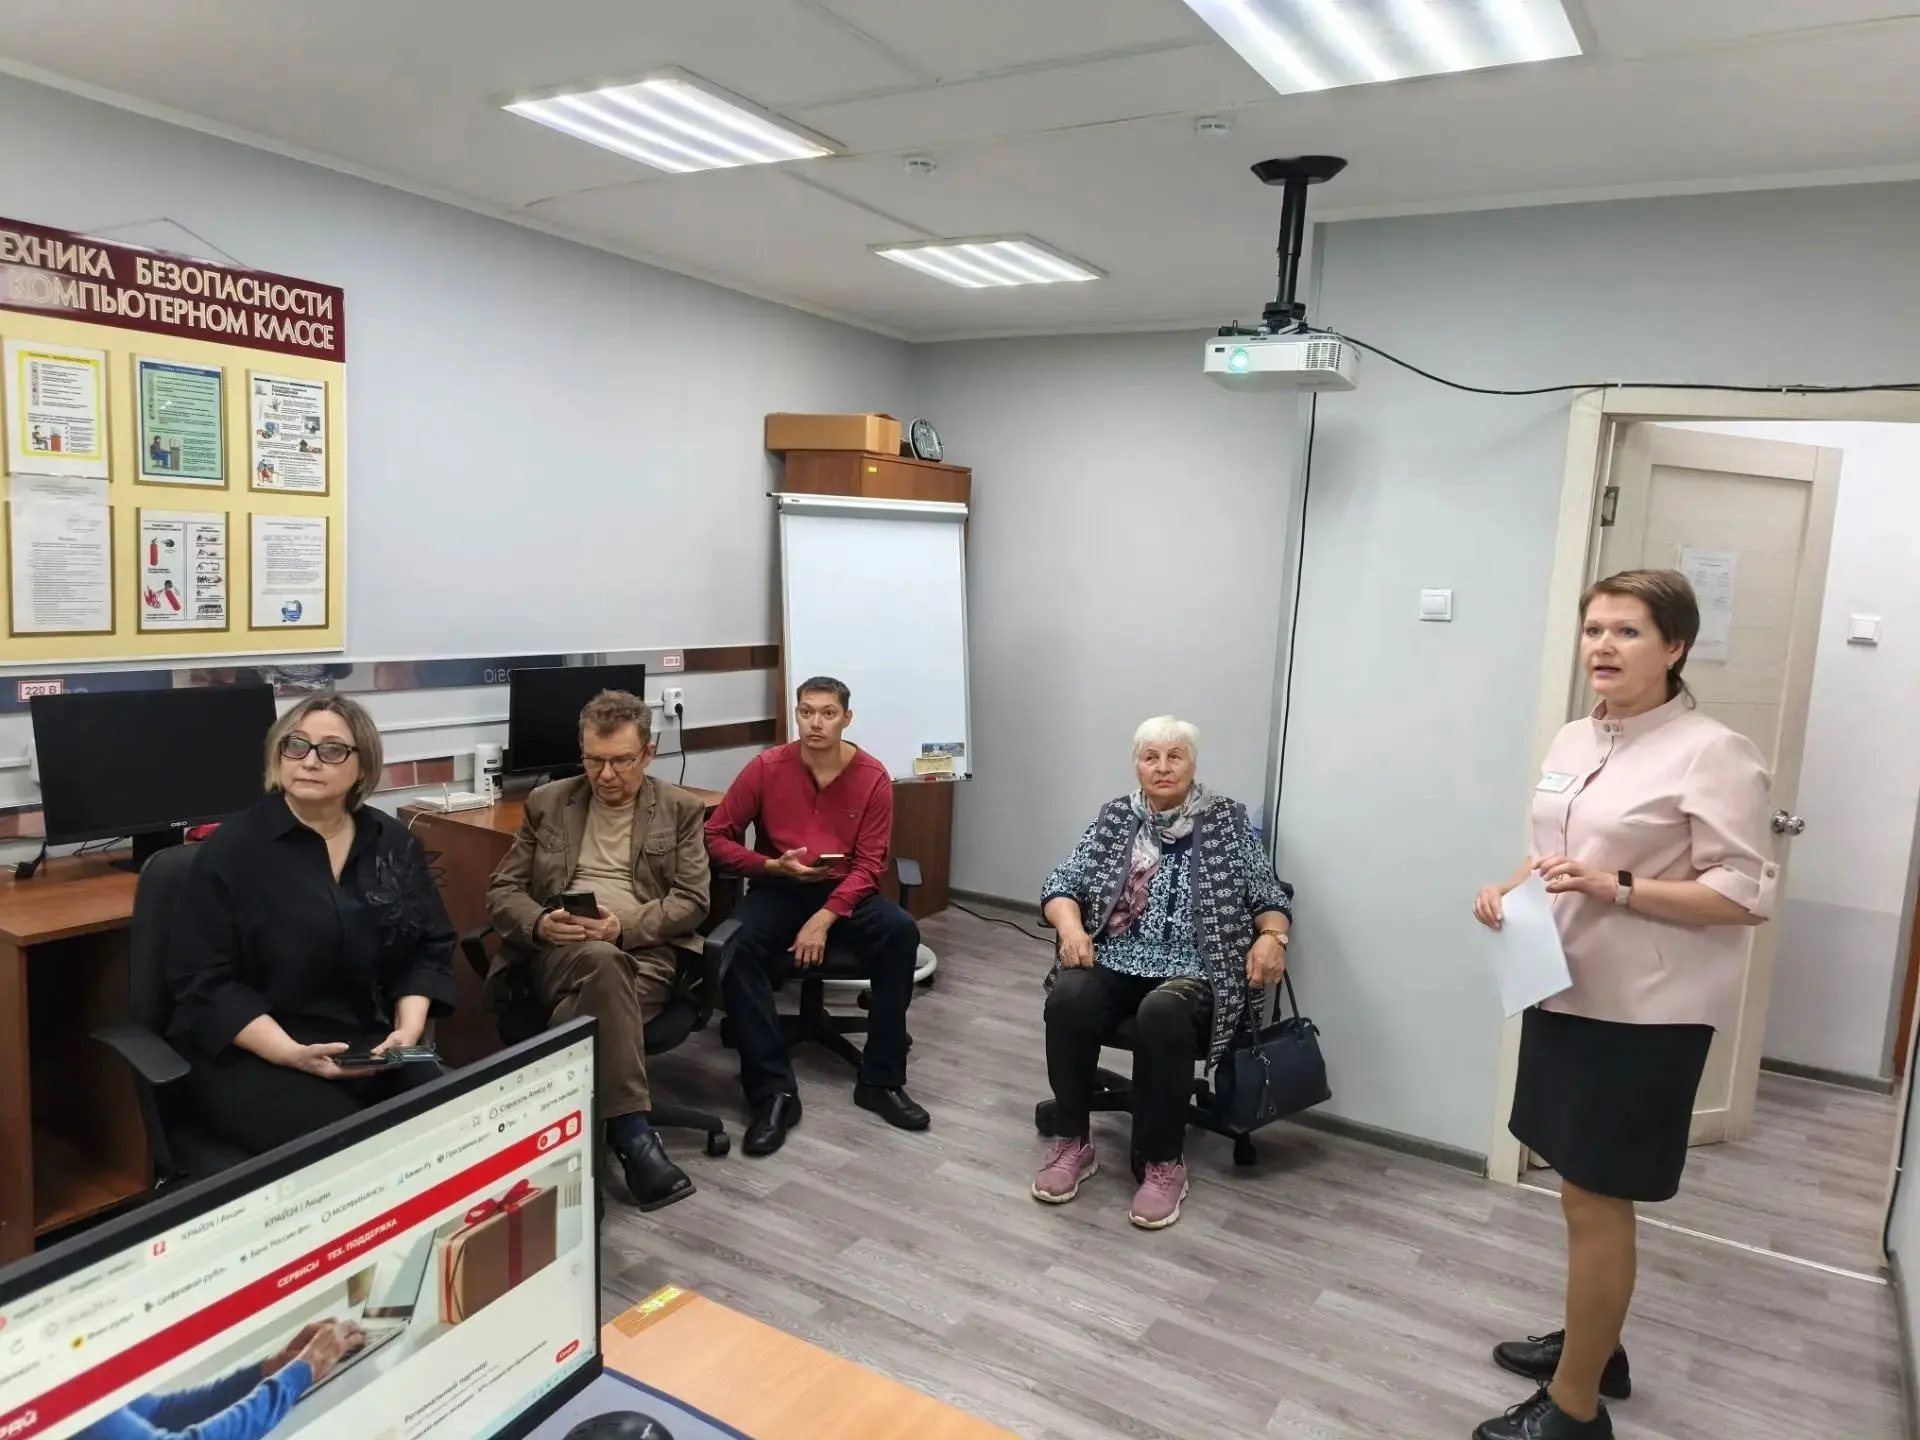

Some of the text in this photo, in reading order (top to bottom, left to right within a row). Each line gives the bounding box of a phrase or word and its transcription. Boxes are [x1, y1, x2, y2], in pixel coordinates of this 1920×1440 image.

[8, 268, 335, 350] КОМПЬЮТЕРНОМ КЛАССЕ
[136, 256, 333, 320] БЕЗОПАСНОСТИ
[25, 686, 45, 696] 220
[276, 1217, 398, 1289] СЕРВИСЫ ТЕХ. ПОДДЕРЖКА
